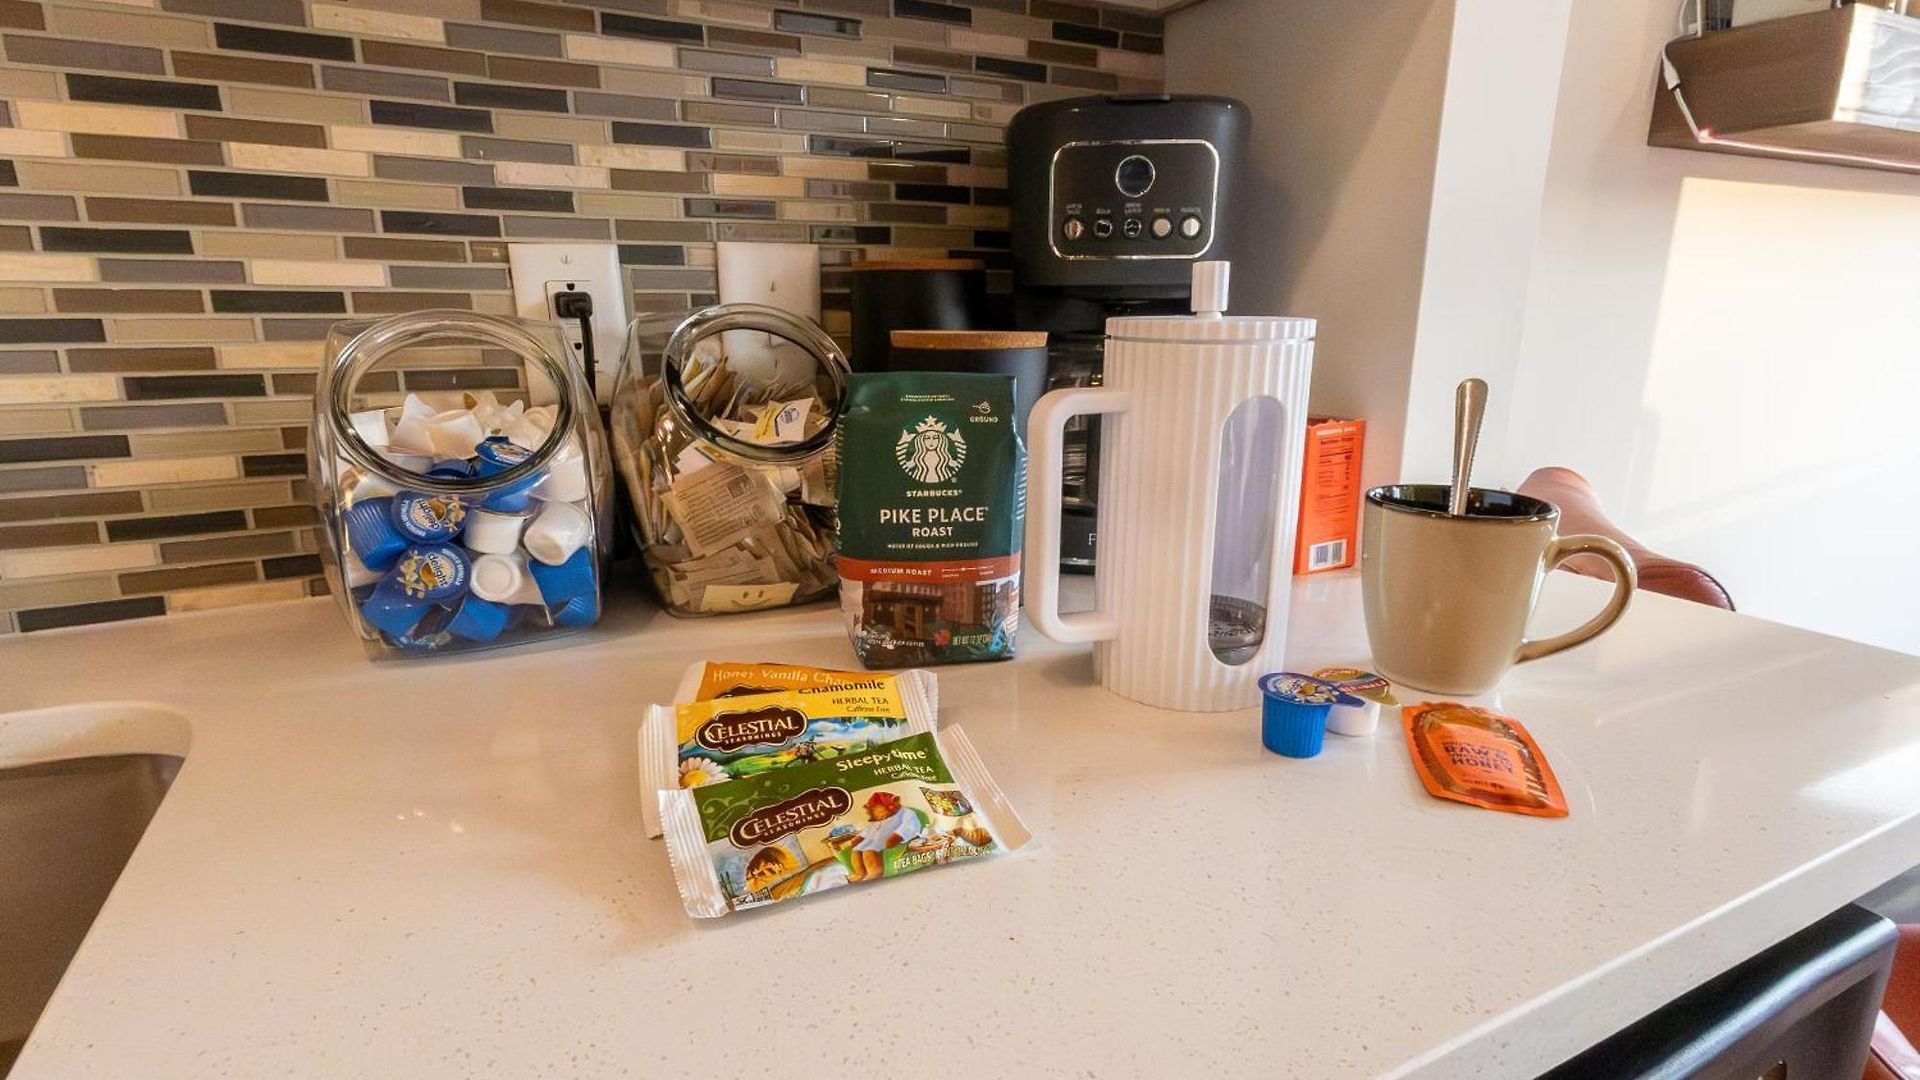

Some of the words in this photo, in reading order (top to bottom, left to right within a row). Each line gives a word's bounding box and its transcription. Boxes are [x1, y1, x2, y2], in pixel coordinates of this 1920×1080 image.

[880, 508, 922, 524] PIKE
[928, 506, 986, 523] PLACE
[912, 526, 953, 537] ROAST
[870, 567, 904, 575] MEDIUM
[905, 568, 932, 576] ROAST
[713, 669, 754, 683] Honey
[761, 669, 809, 682] Vanilla
[832, 696, 870, 705] HERBAL
[871, 696, 889, 705] TEA
[704, 715, 800, 743] CELESTIAL
[725, 731, 782, 745] SEASONINGS
[836, 748, 927, 772] Sleepytime
[1450, 758, 1515, 775] HONEY
[873, 763, 912, 776] HERBAL
[914, 765, 935, 774] TEA
[740, 795, 844, 839] CELESTIAL
[763, 811, 826, 836] SEASONINGS
